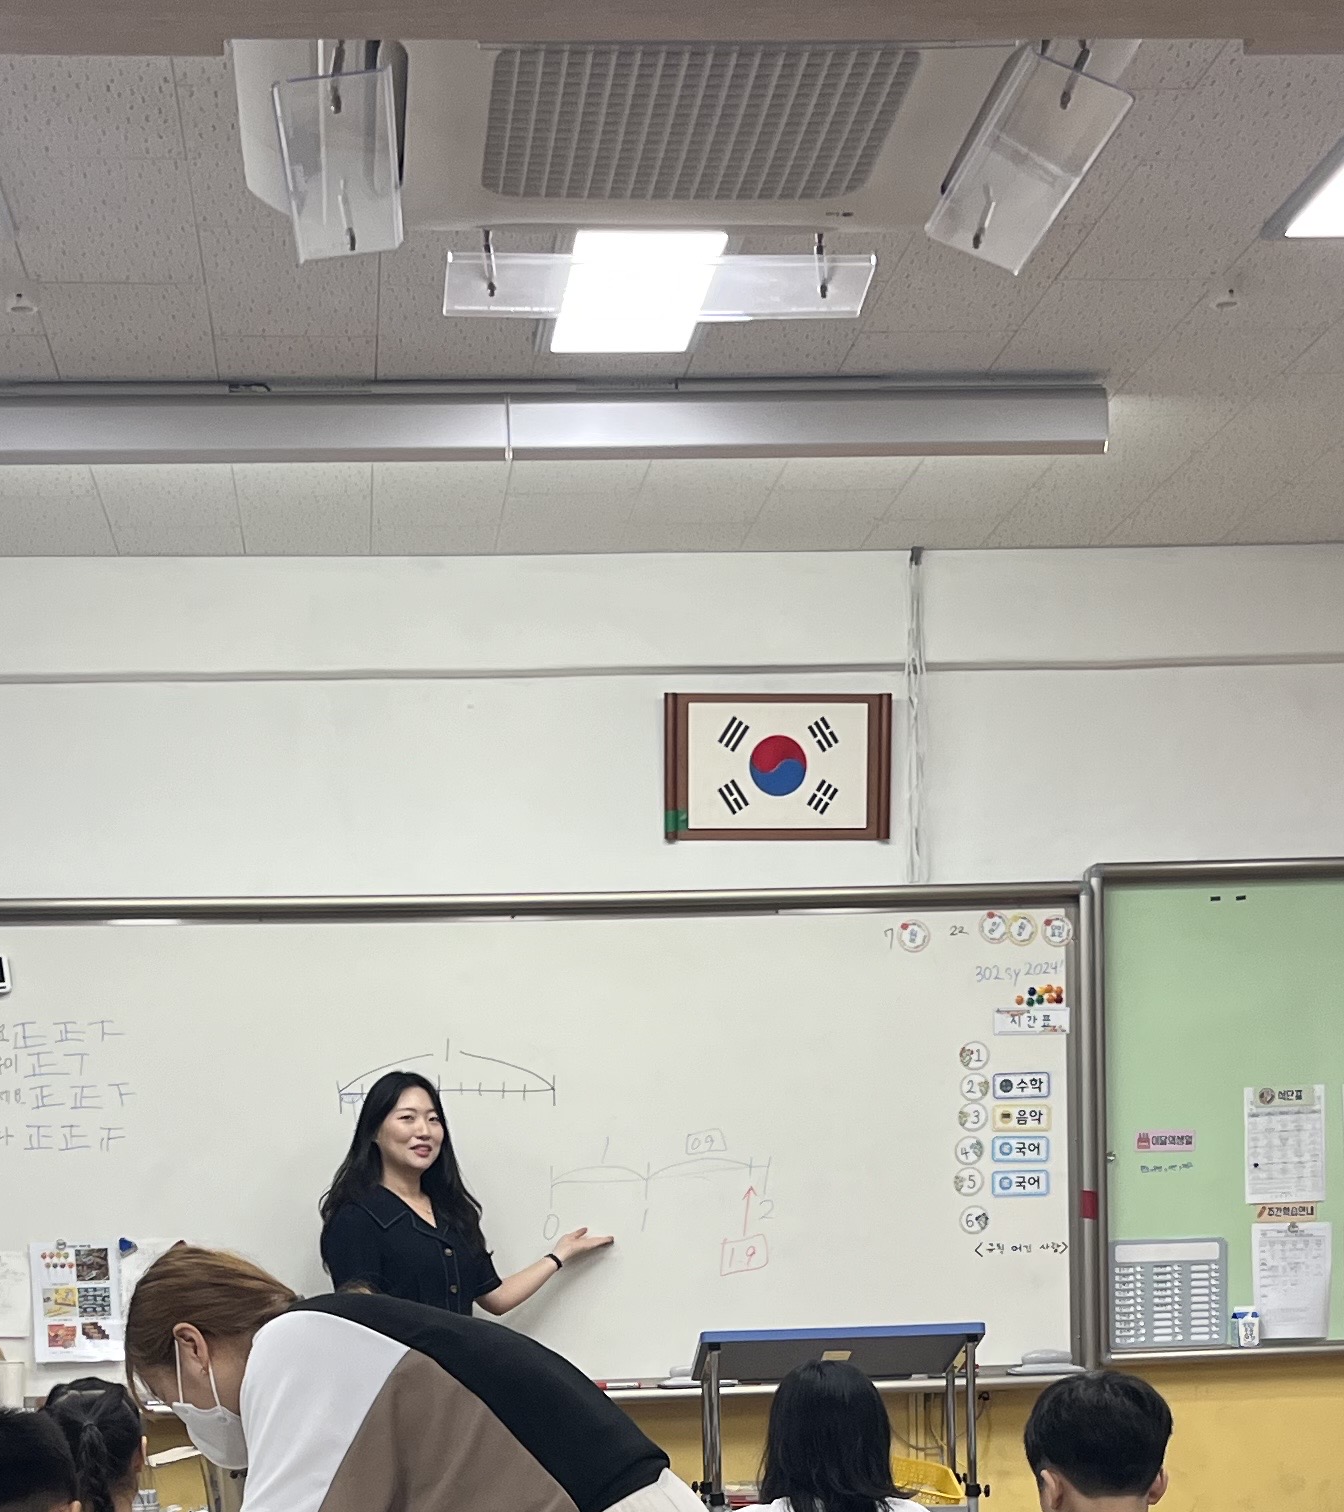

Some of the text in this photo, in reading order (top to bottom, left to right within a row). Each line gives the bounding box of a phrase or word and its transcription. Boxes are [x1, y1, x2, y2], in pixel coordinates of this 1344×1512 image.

[949, 925, 970, 936] 22
[975, 965, 1005, 983] 302
[974, 1048, 983, 1063] 1
[965, 1080, 976, 1094] 2
[1015, 1077, 1045, 1093] 수학
[971, 1110, 981, 1125] 3
[1015, 1109, 1044, 1126] 음악
[960, 1147, 970, 1161] 4
[1014, 1141, 1041, 1157] 국어
[966, 1175, 977, 1190] 5
[1014, 1175, 1041, 1190] 국어
[758, 1199, 775, 1220] 2
[965, 1213, 975, 1228] 6
